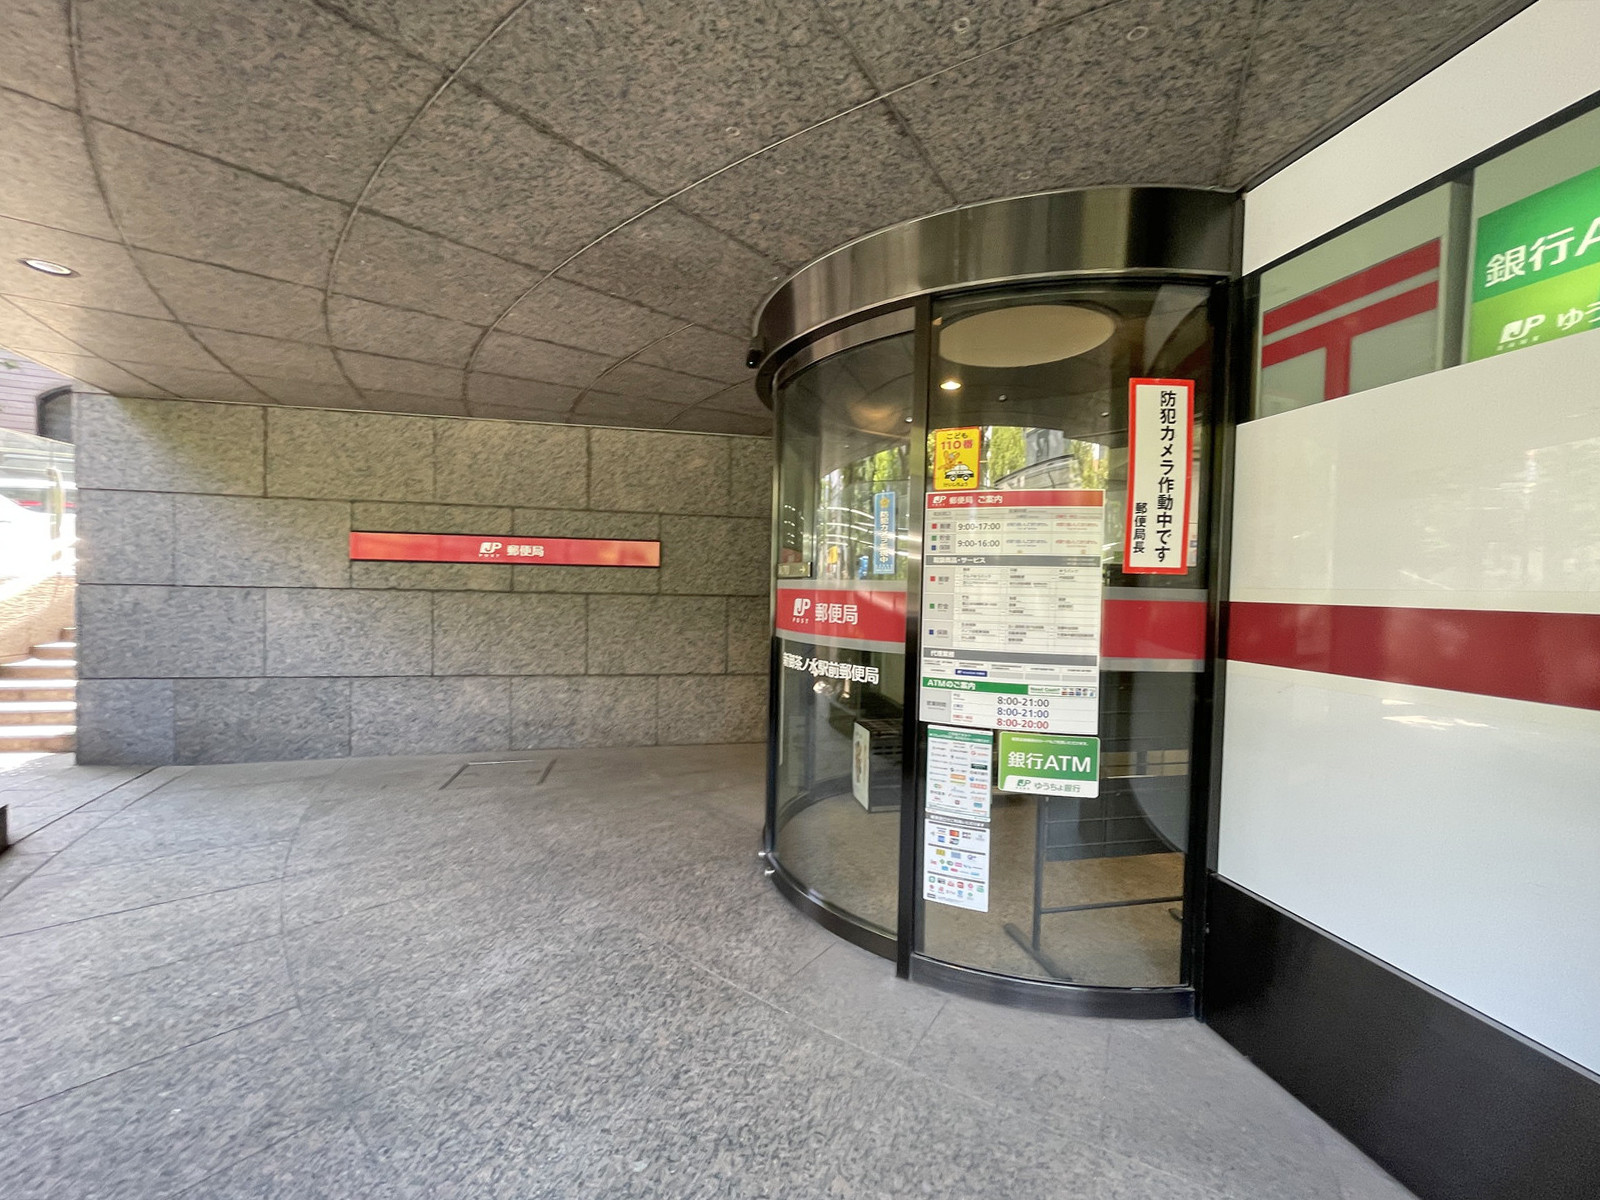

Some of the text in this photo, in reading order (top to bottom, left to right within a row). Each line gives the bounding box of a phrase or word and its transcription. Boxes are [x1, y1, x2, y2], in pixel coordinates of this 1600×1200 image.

[946, 432, 969, 440] こども
[1155, 391, 1177, 562] 防犯カメラ作動中です
[948, 496, 974, 505] 郵便局
[977, 495, 1004, 505] ご案内
[957, 522, 1001, 531] 9:00-17:00
[1132, 502, 1148, 554] 郵便局長
[957, 539, 1001, 548] 9:00-16:00
[507, 545, 544, 557] 郵便局
[815, 602, 859, 625] 郵便局
[996, 695, 1050, 708] 8:00-21:00
[996, 707, 1050, 719] 8:00-21:00
[996, 717, 1050, 730] 8:00-20:00
[1007, 751, 1092, 773] 銀行ATM
[1034, 782, 1082, 793] ゆうちょ銀行
